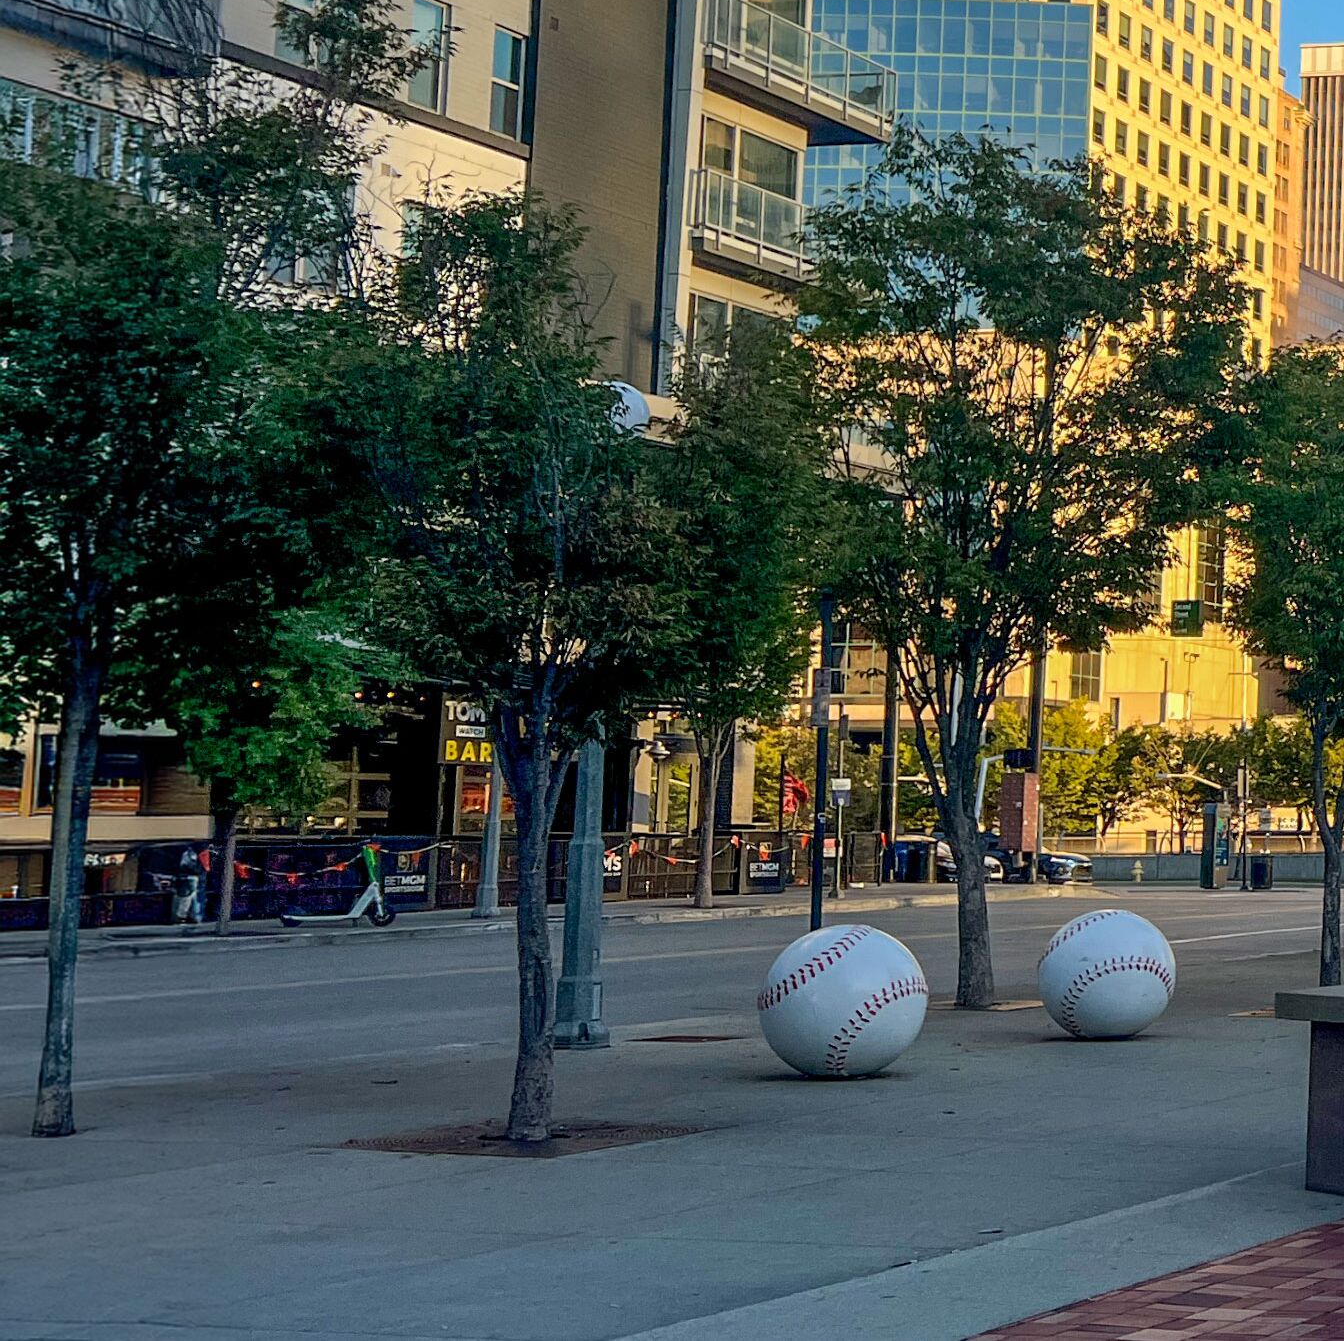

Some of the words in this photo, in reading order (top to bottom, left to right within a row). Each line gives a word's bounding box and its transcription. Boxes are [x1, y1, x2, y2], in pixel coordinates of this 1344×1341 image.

[459, 727, 484, 735] WATCH
[445, 740, 493, 762] BAR
[385, 875, 426, 885] BETMGM
